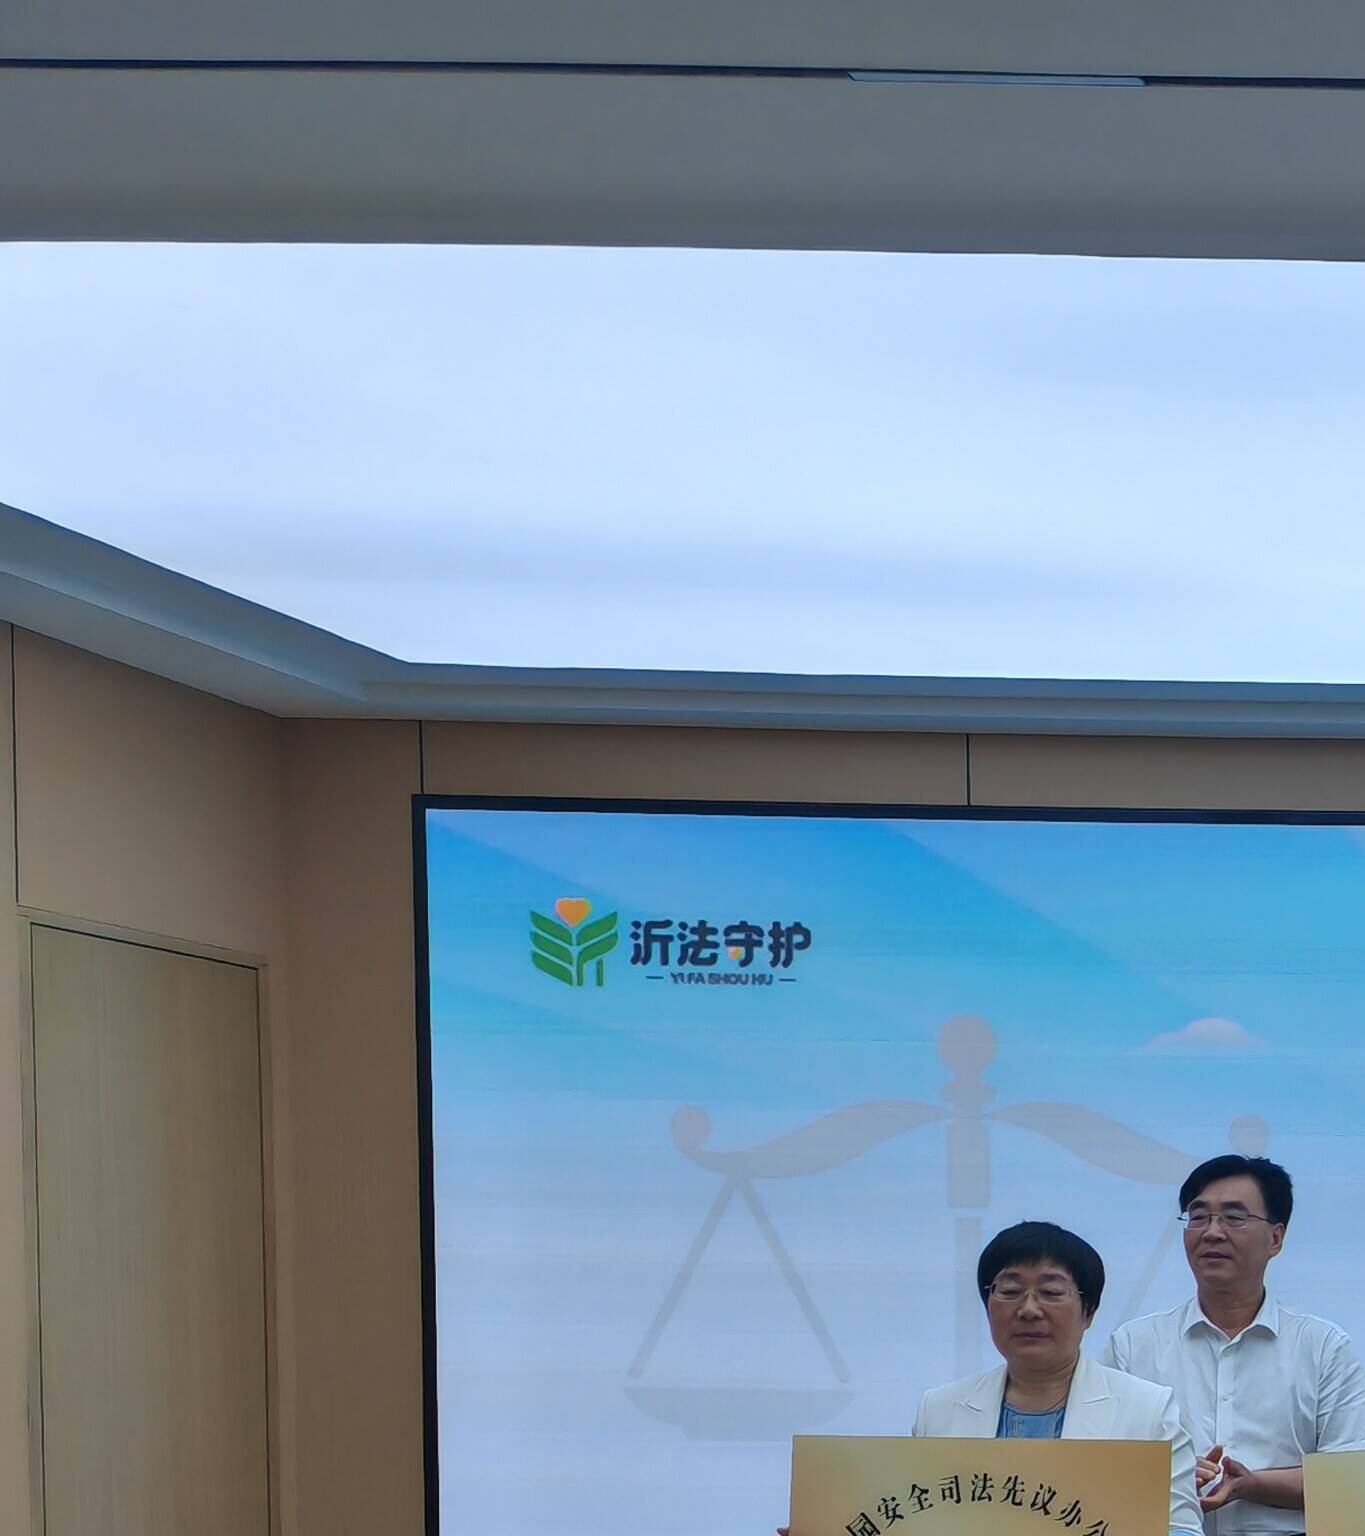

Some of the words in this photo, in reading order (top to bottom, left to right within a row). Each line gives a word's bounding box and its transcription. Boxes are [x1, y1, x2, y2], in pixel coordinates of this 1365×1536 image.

[629, 918, 812, 969] 沂法守护
[669, 971, 685, 984] YI
[686, 972, 706, 985] FA
[707, 972, 749, 986] SHOU
[751, 973, 775, 987] HU
